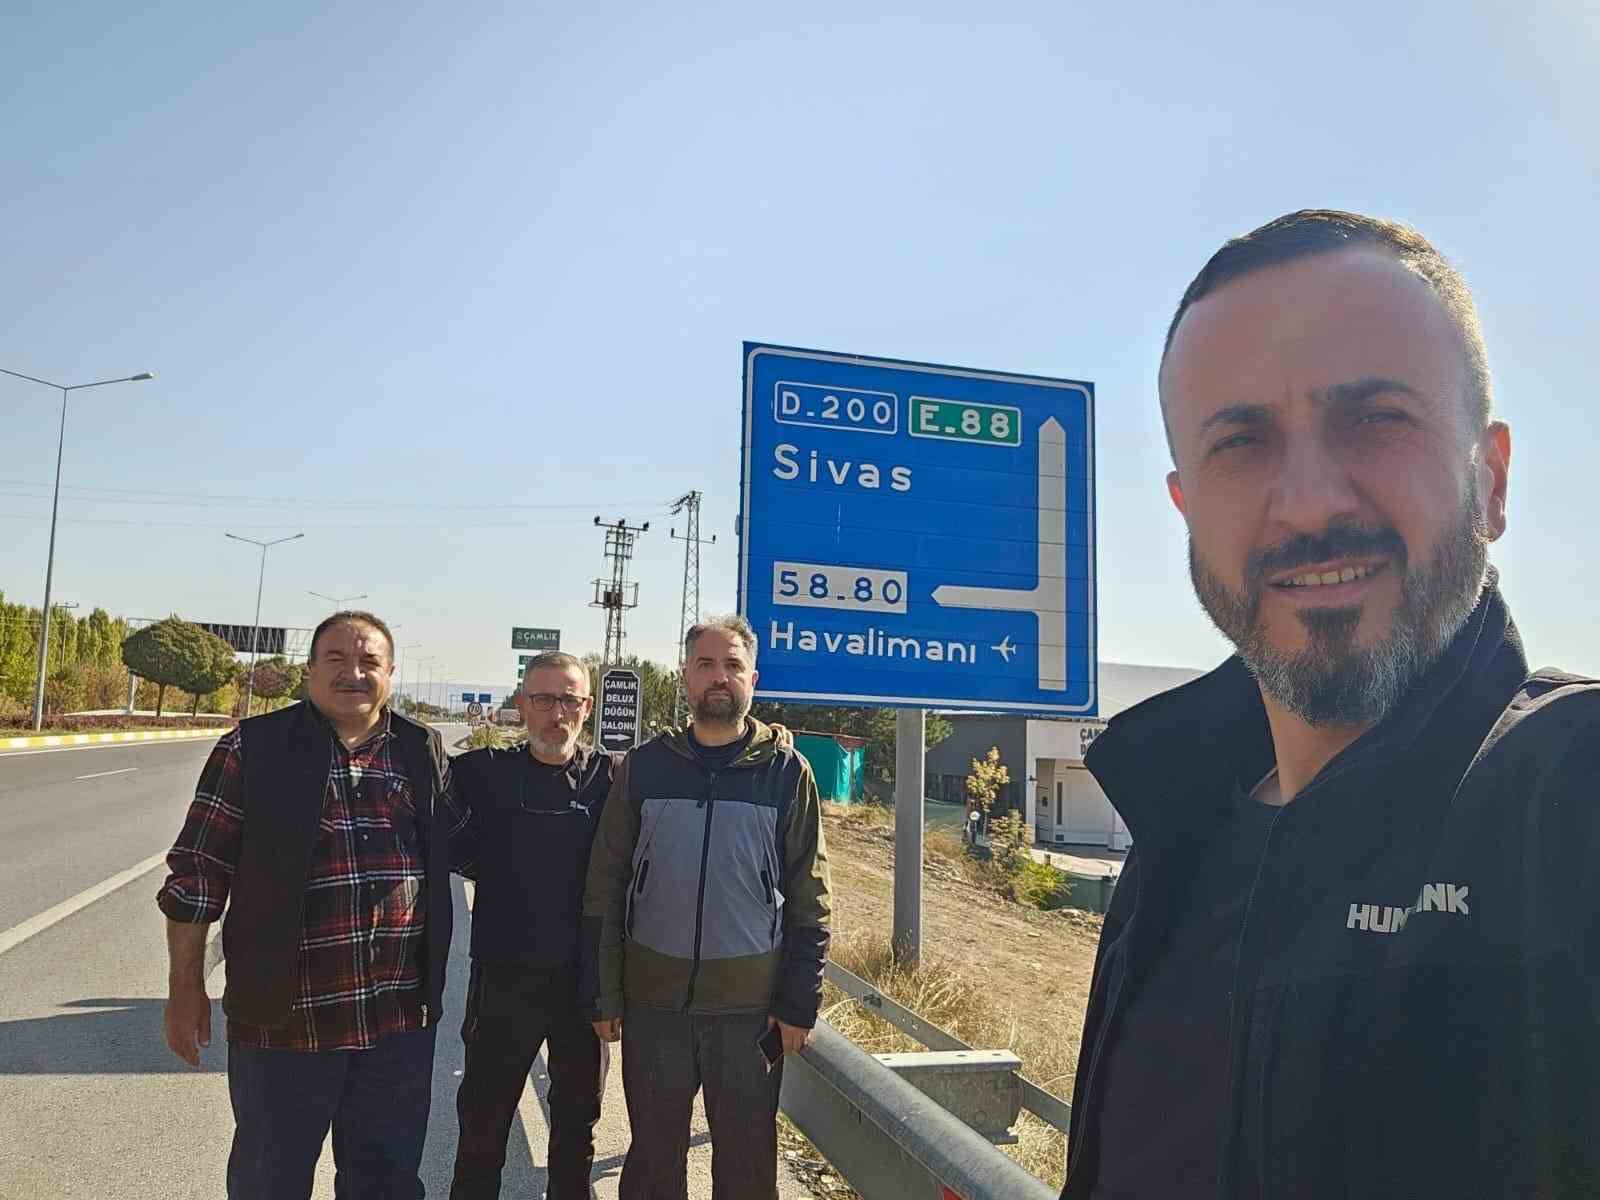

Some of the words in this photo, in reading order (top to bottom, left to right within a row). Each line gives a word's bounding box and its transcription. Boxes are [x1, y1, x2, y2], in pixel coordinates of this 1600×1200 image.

[772, 443, 913, 492] Sivas
[778, 570, 903, 605] 58.80
[770, 620, 977, 664] Havalimanı
[604, 680, 637, 691] ÇAMLIK
[606, 693, 635, 703] DELUX
[604, 705, 635, 717] DÜĞÜN
[601, 720, 636, 731] SALONU
